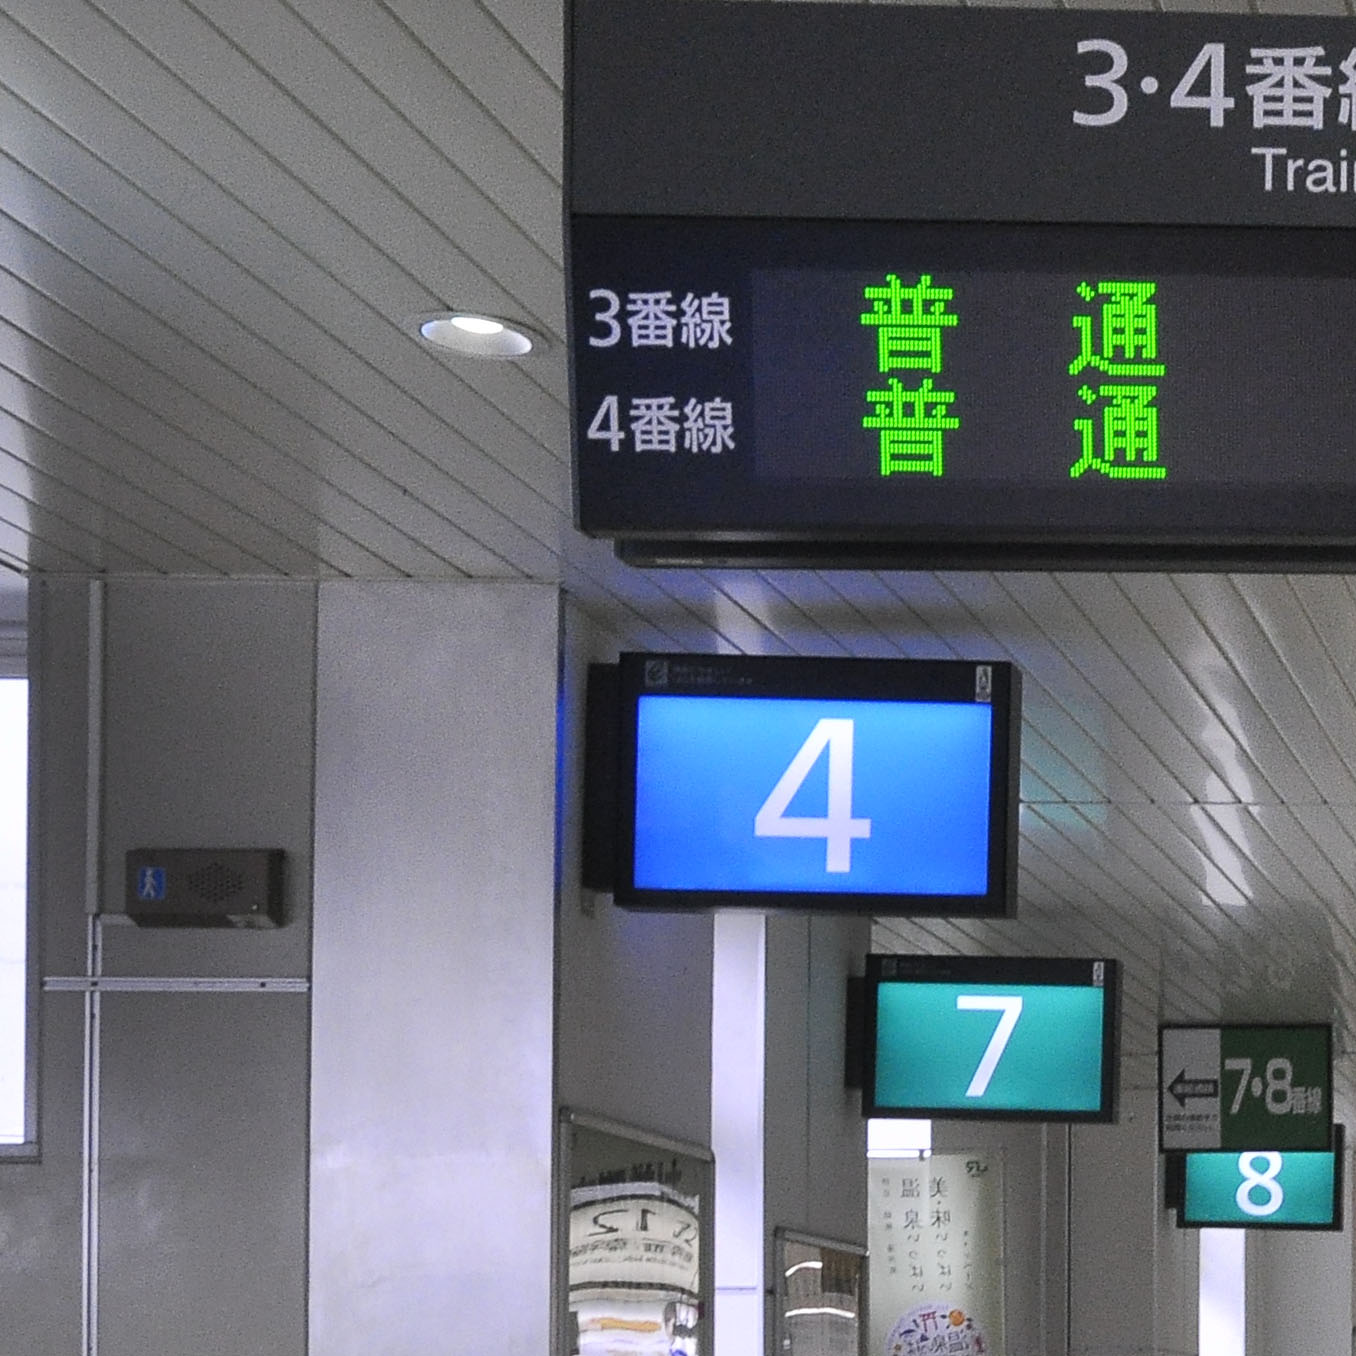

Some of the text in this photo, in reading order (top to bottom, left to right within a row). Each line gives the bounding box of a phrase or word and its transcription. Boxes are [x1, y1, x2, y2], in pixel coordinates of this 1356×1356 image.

[588, 289, 734, 350] 3番線
[586, 395, 736, 454] 4番線
[753, 717, 872, 874] 4
[956, 995, 1024, 1098] 7
[1236, 1151, 1284, 1216] 8
